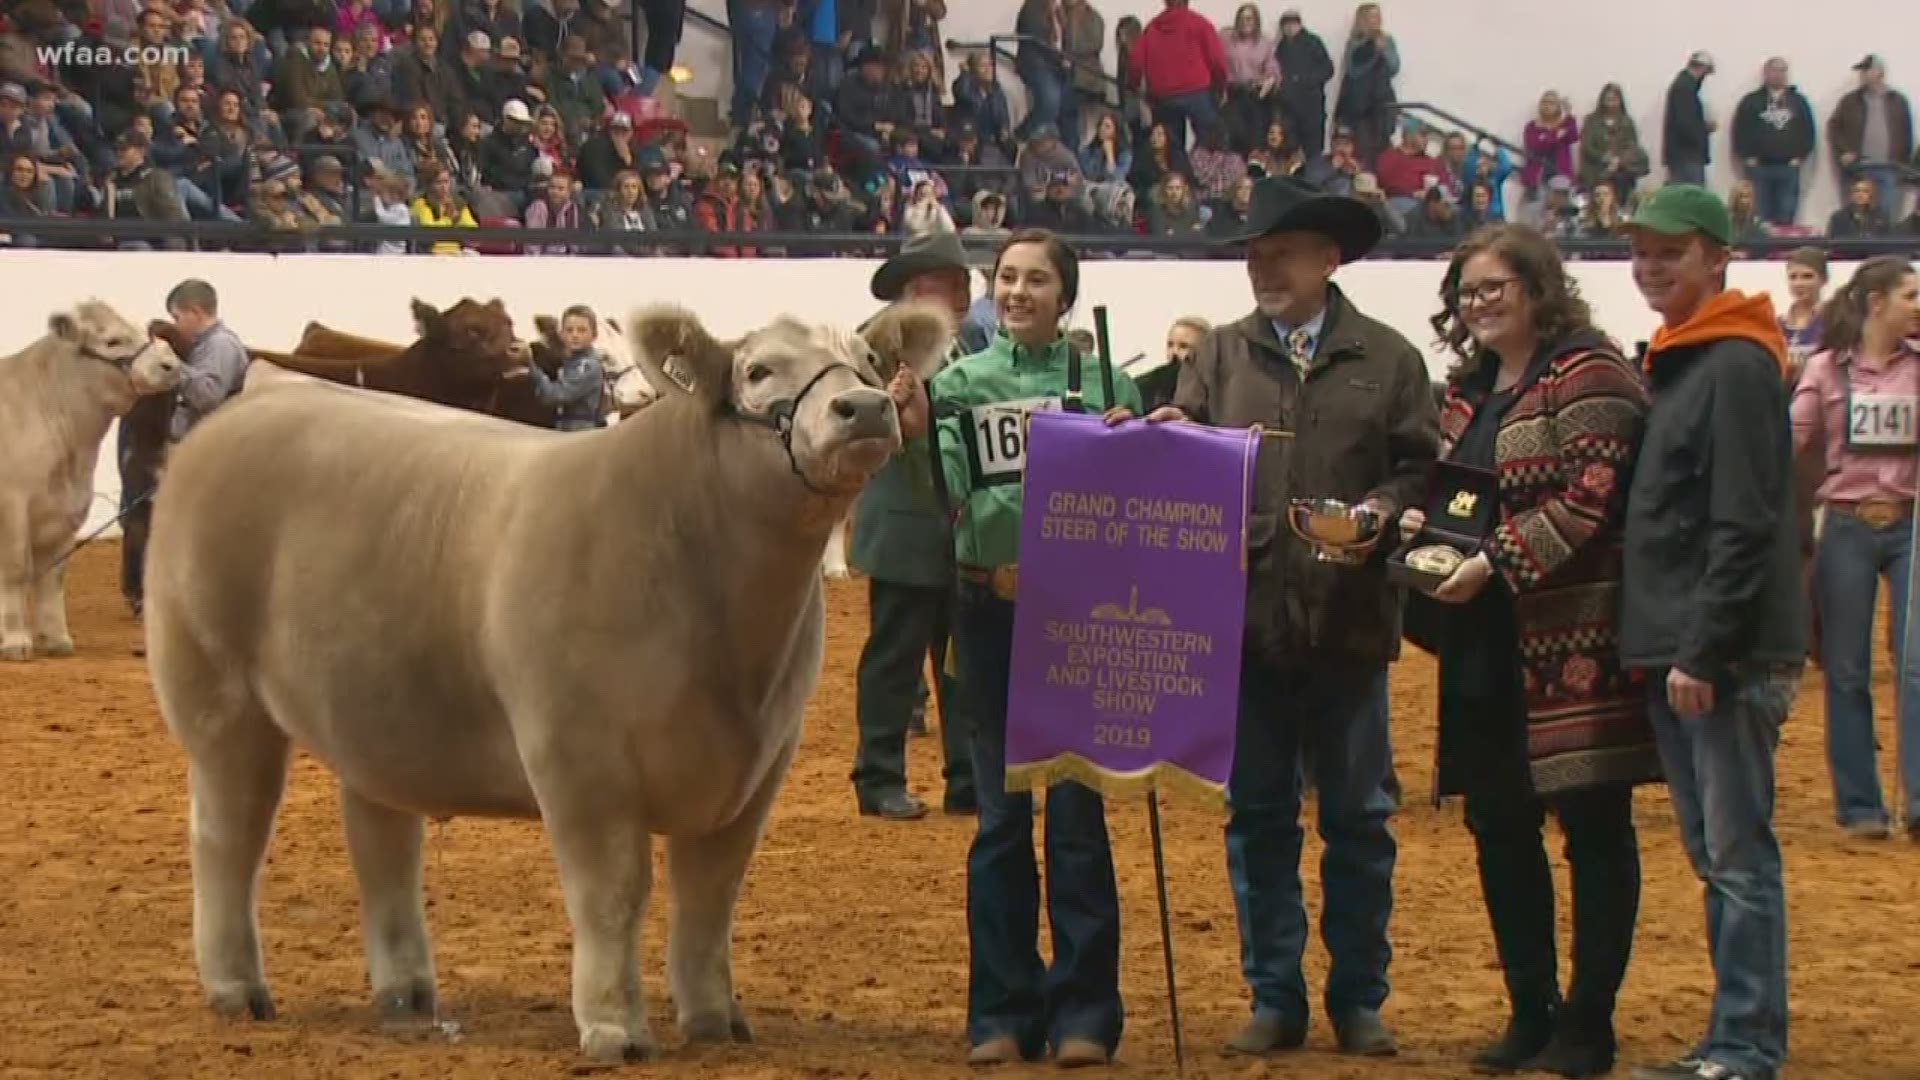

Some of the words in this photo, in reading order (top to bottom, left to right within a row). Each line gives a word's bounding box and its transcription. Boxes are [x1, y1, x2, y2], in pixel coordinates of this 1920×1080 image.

[1853, 404, 1912, 437] 2141
[1049, 491, 1116, 518] GRAND
[1125, 498, 1224, 527] CHAMPION
[1041, 516, 1097, 541] STEER
[1105, 521, 1128, 546] OF
[1138, 525, 1170, 549] THE
[1176, 528, 1228, 553] SHOW
[1046, 620, 1213, 655] SOUTHWESTERN
[1068, 643, 1187, 674] EXPOSITION
[1046, 665, 1091, 687] AND
[1096, 669, 1205, 697] LIVESTOCK
[1091, 690, 1156, 715] SHOW
[1093, 724, 1151, 749] 2019
